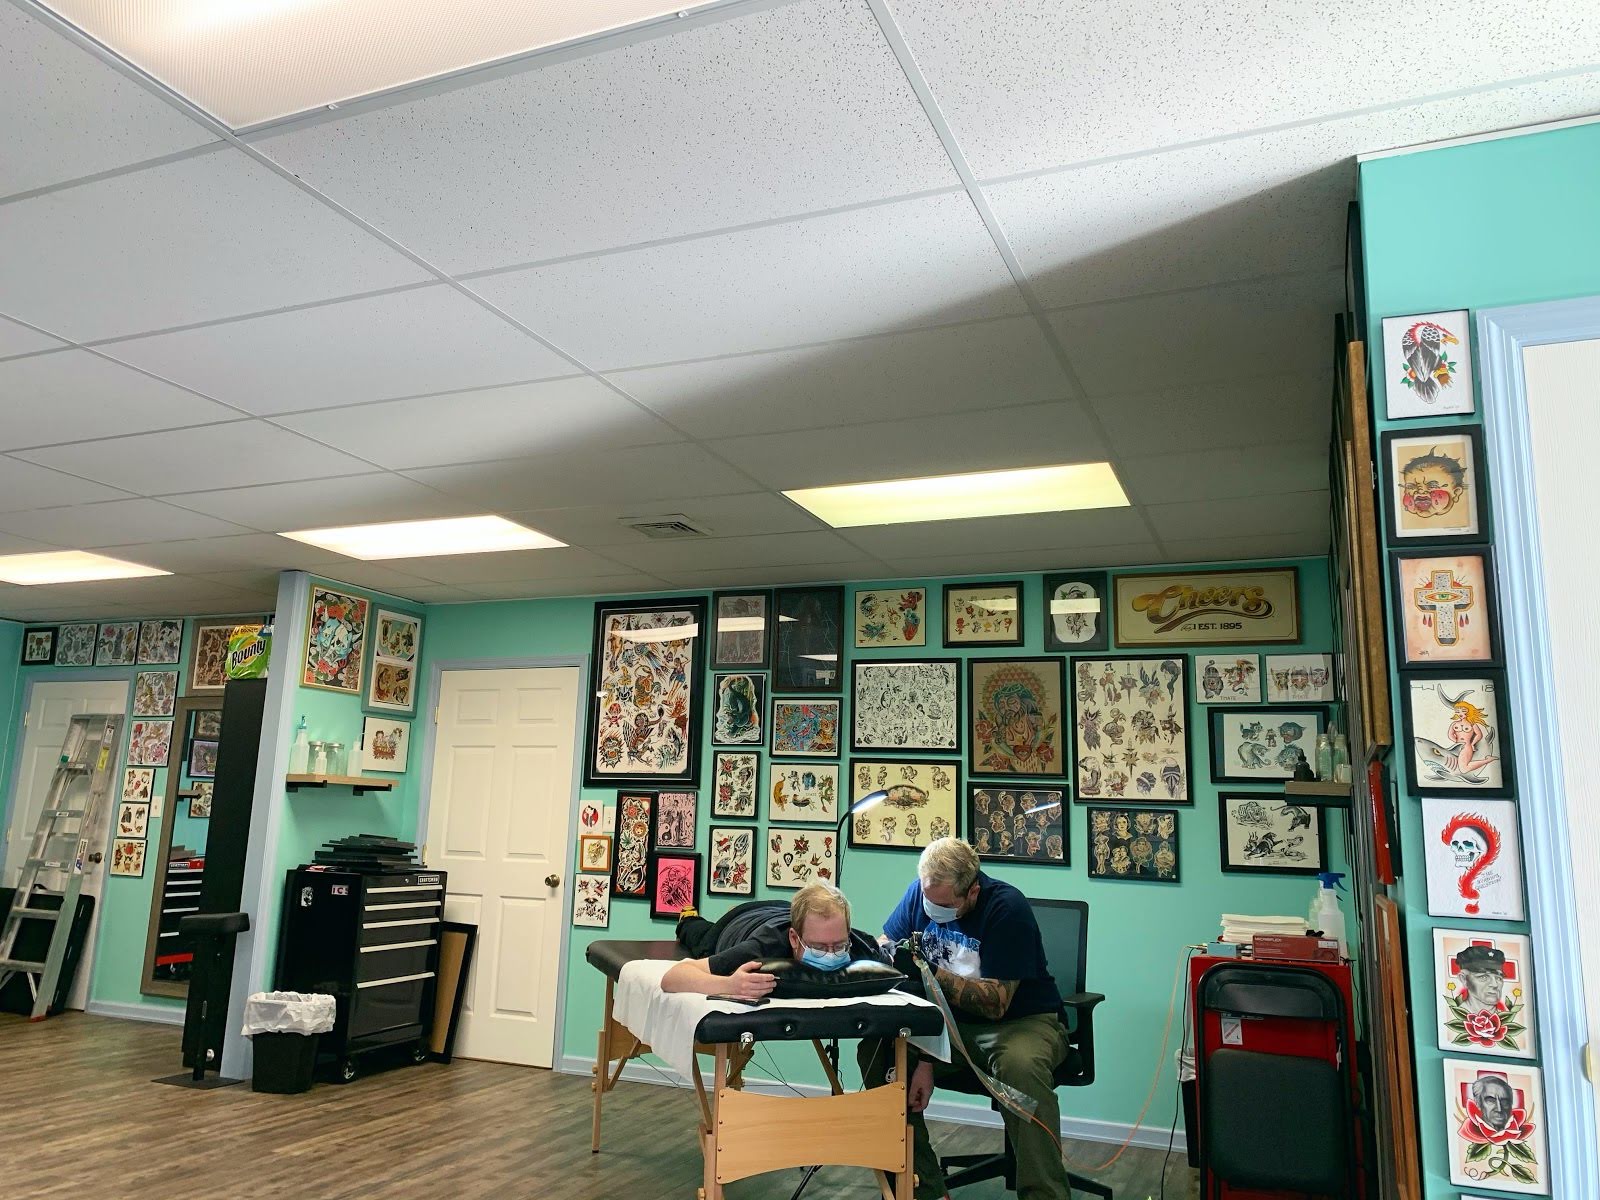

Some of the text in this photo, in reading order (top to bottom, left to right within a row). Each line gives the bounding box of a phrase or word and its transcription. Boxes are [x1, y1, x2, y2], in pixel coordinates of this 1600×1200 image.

[1131, 584, 1272, 626] Cheers
[1198, 622, 1243, 630] EST. 1895
[231, 639, 266, 671] Bounty
